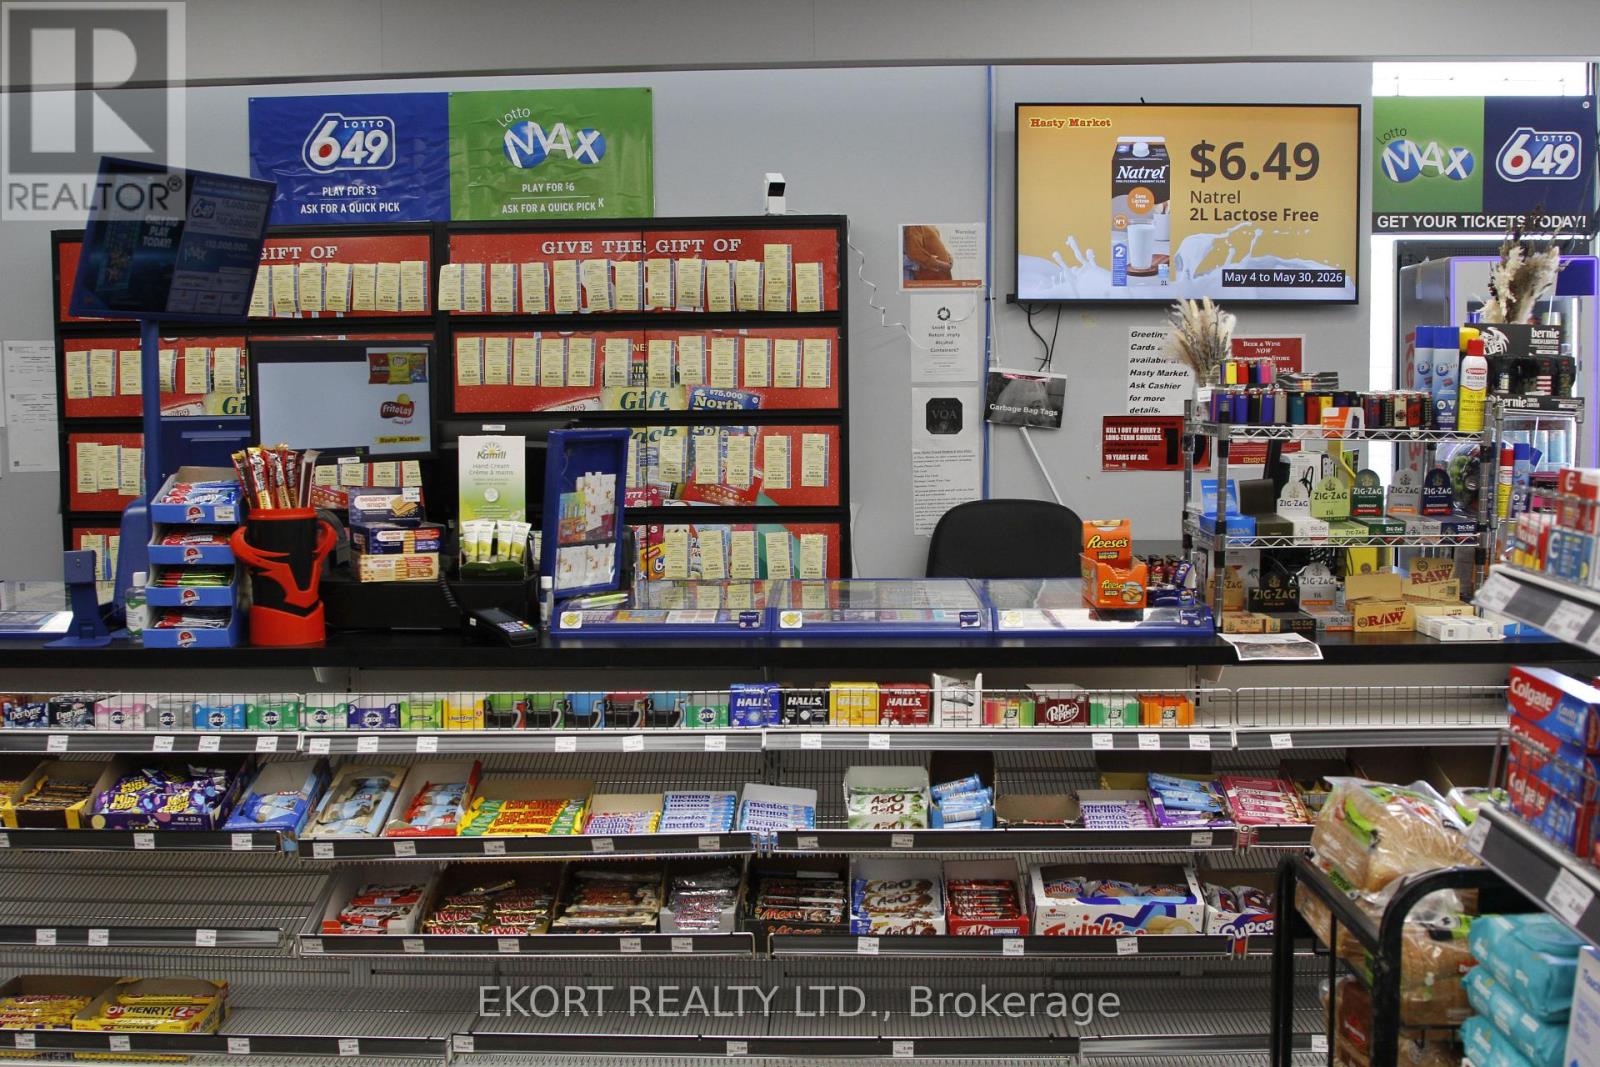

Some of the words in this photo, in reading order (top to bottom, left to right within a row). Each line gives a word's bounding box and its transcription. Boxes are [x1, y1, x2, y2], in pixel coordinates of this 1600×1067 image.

[497, 107, 531, 128] Lotto
[1030, 118, 1066, 129] Hasty
[1069, 117, 1112, 128] Market
[344, 120, 384, 128] LOTTO
[1377, 127, 1407, 145] Lotto
[504, 120, 601, 169] MAX
[1190, 140, 1320, 183] $6.49
[1381, 140, 1470, 182] MAX
[1115, 165, 1168, 179] Natrel
[322, 186, 344, 196] PLAY
[347, 186, 363, 196] FOR
[366, 185, 377, 195] $3
[522, 183, 543, 193] PLAY
[546, 182, 563, 192] FOR
[565, 182, 575, 192] $6
[1190, 190, 1241, 204] Natrel
[301, 204, 318, 214] ASK
[320, 204, 335, 214] FOR
[337, 204, 347, 213] A
[349, 203, 378, 213] QUICK
[379, 202, 401, 213] PICK
[502, 203, 519, 214] ASK
[521, 203, 537, 213] FOR
[539, 202, 546, 212] A
[548, 202, 574, 212] QUICK
[576, 201, 596, 211] PICK
[1189, 208, 1209, 221] 2L
[1213, 207, 1278, 222] Lactose
[1283, 208, 1320, 221] Free
[1377, 215, 1409, 229] GET
[1412, 215, 1457, 229] YOUR
[1461, 214, 1526, 229] TICKETS
[310, 245, 339, 259] OF
[541, 240, 593, 254] GIVE
[602, 240, 647, 253] THE
[655, 239, 705, 253] GIFT
[713, 238, 742, 252] OF
[1115, 246, 1124, 258] 2
[1224, 272, 1247, 284] May
[1249, 272, 1257, 282] 4
[1259, 273, 1271, 282] to
[1273, 272, 1296, 284] May
[1297, 272, 1315, 284] 30,
[1317, 272, 1344, 283] 2026
[1531, 327, 1560, 339] bernie
[1129, 369, 1155, 377] Hasty
[1148, 382, 1182, 390] Cashier
[619, 389, 670, 411] Gift
[709, 389, 744, 400] $75,000
[694, 396, 744, 410] North
[989, 403, 1022, 414] Garbage
[1023, 406, 1039, 416] Bag
[1040, 407, 1059, 417] Tags
[476, 450, 507, 460] Kamill
[1314, 491, 1348, 500] ZIG-ZAG
[1353, 487, 1383, 495] ZIG-ZAG
[1391, 486, 1419, 494] ZIG-ZAG
[1423, 487, 1452, 495] ZIG-ZAG
[1280, 499, 1309, 507] ZIG-ZAG
[1087, 535, 1128, 549] Reese's
[1301, 577, 1335, 585] ZIG-ZAG
[1411, 568, 1452, 585] RAW
[1252, 589, 1297, 600] ZIG-ZAG
[1367, 611, 1405, 626] RAW
[1510, 676, 1553, 712] Colgate
[736, 697, 771, 707] HALLS
[787, 696, 823, 706] HALLS
[886, 697, 922, 707] HALLS
[10, 706, 41, 721] Dentyne
[1047, 705, 1078, 722] Pepper
[1058, 703, 1070, 712] Dr
[664, 821, 706, 829] mentos
[128, 1005, 175, 1017] HENRY!
